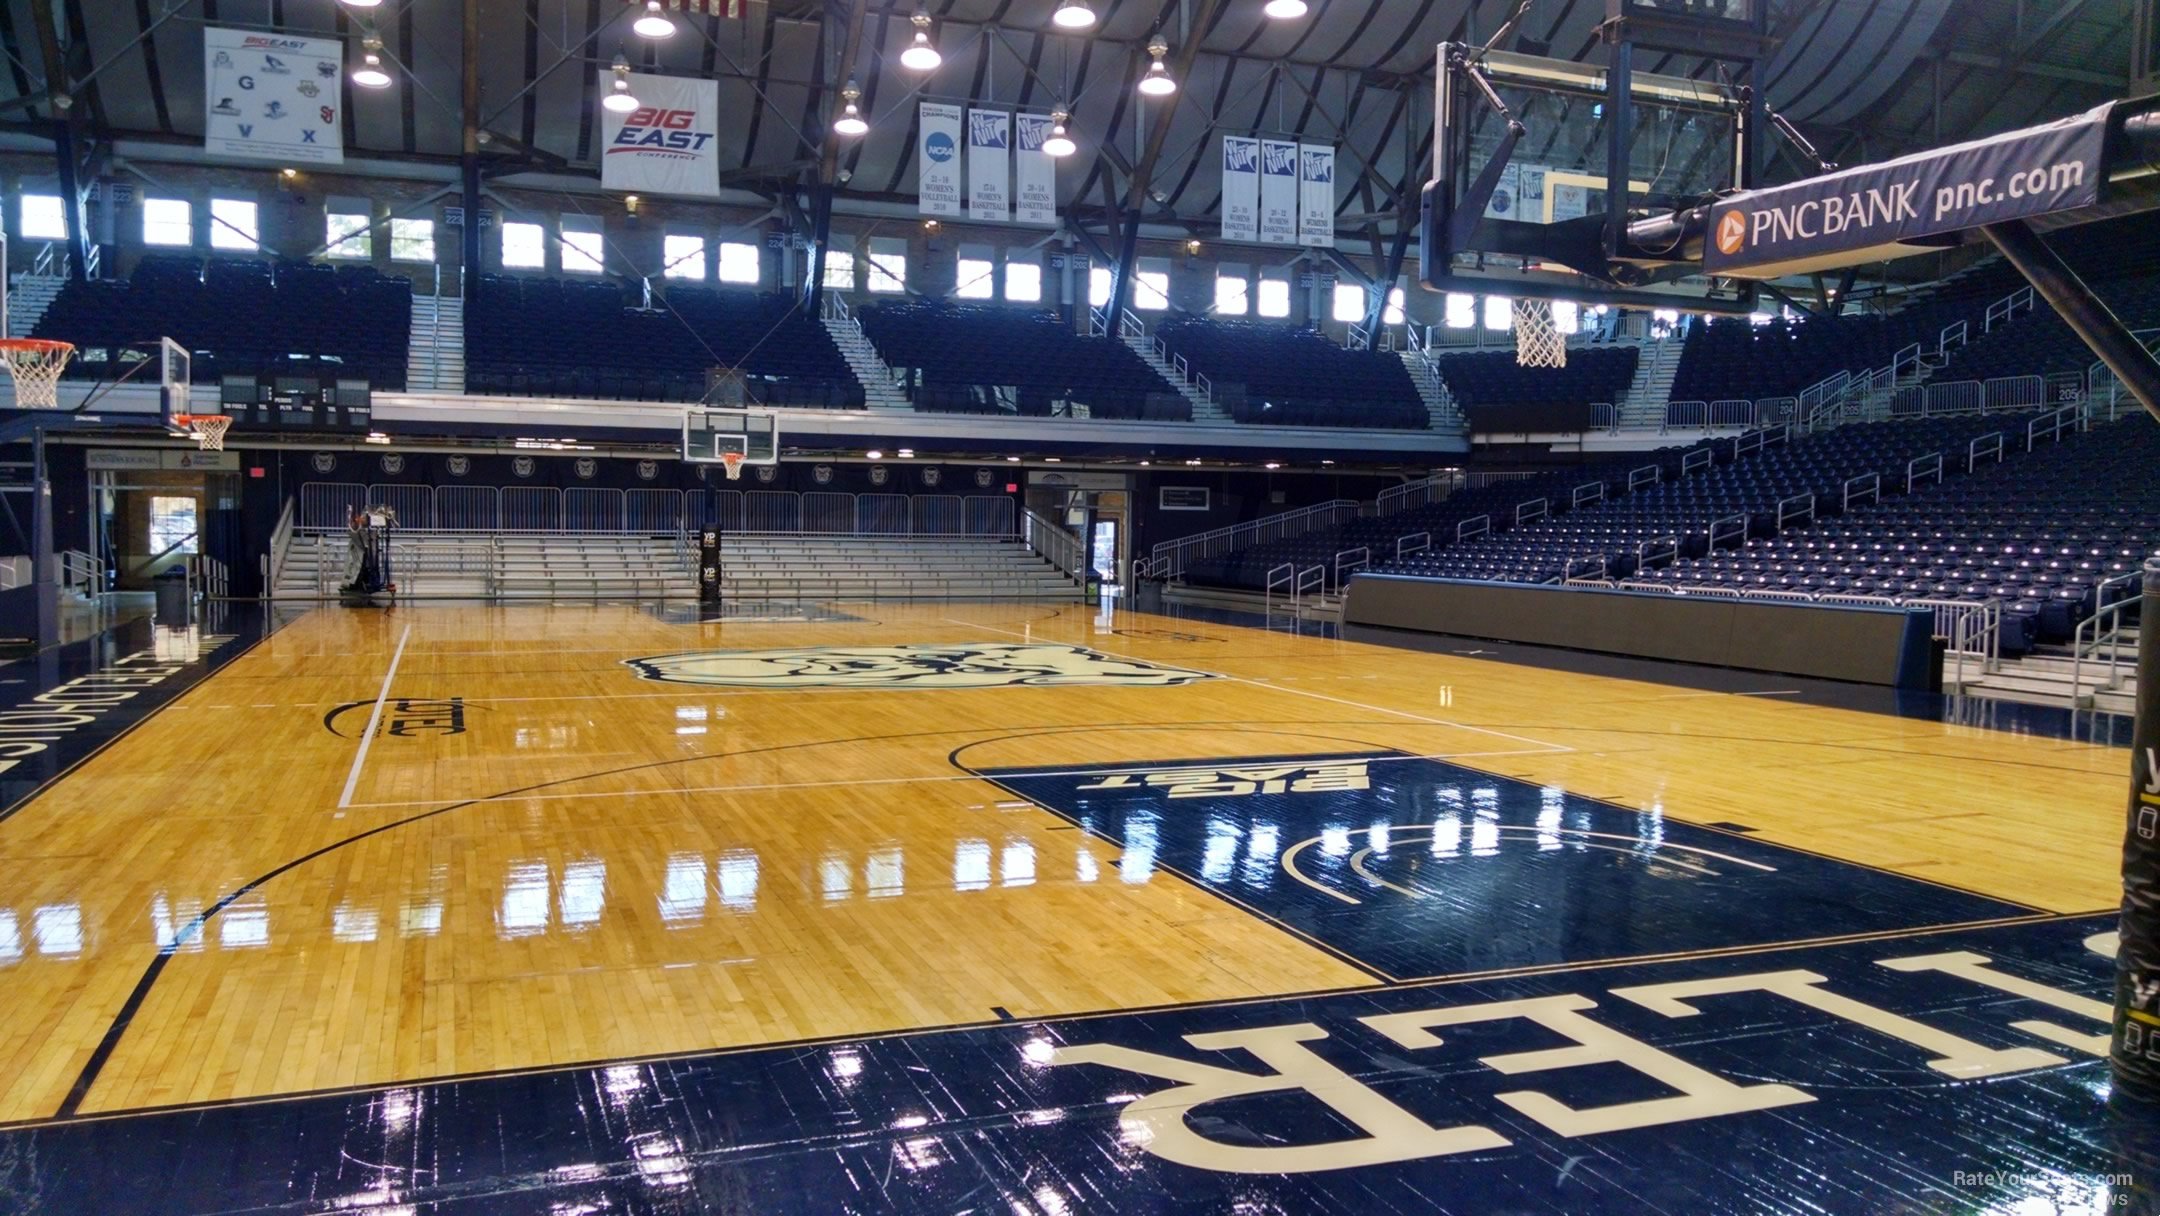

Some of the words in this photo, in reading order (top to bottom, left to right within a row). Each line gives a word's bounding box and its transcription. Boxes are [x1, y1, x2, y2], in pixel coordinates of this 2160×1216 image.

[238, 75, 255, 90] G
[624, 107, 696, 130] BIG
[922, 111, 959, 121] CHAMPIONS
[238, 124, 253, 138] V
[302, 130, 316, 143] X
[613, 126, 714, 151] EAST
[636, 152, 697, 161] CONFERENCE
[928, 145, 954, 156] NCAA
[1935, 160, 2084, 221] pnc.com
[920, 192, 959, 202] VOLLEYBALL
[972, 201, 1007, 211] BASKETBALL
[1018, 201, 1054, 211] BASKETBALL
[1224, 221, 1255, 232] BASKETBALL
[1263, 225, 1294, 235] BASKETBALL
[1300, 227, 1333, 237] BASKETBALL
[2059, 388, 2078, 401] 205
[1076, 762, 1369, 790] EAST
[1167, 775, 1371, 799] BIG
